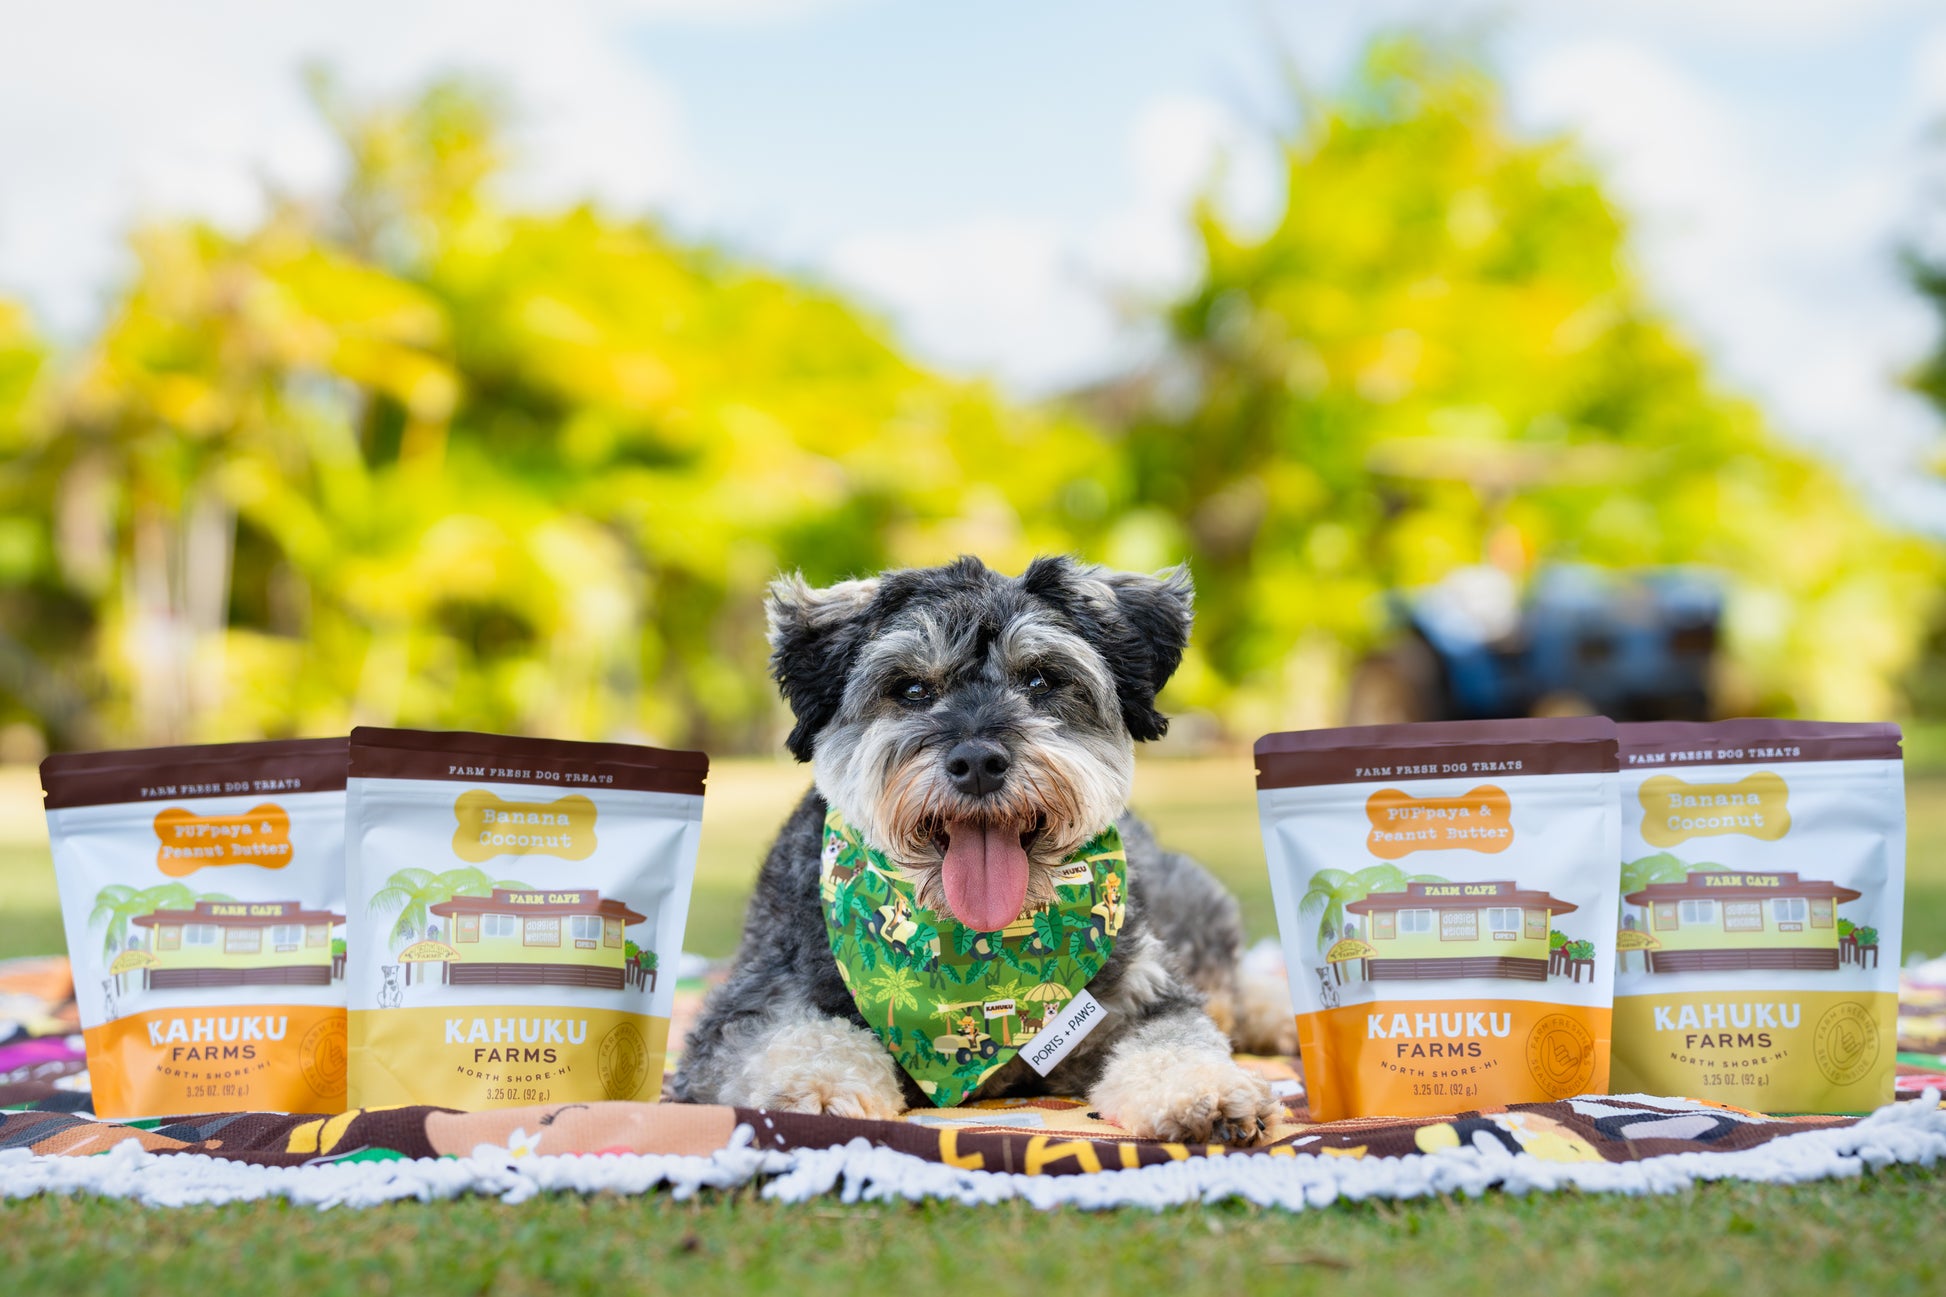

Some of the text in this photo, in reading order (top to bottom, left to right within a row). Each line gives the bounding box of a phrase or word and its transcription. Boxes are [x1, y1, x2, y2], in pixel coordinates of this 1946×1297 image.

[1629, 747, 1801, 764] FARM FRESH DOG TREATS
[449, 765, 614, 784] FARM FRESH DOG TREATS
[1355, 760, 1522, 777] FARM FRESH DOG TREATS
[141, 778, 301, 797] FARM FRESH DOG TREATS
[1667, 792, 1760, 808] Banana
[482, 808, 570, 827] Banana
[1480, 804, 1491, 816] &
[260, 822, 272, 834] &
[1667, 812, 1764, 830] Coconut
[479, 831, 572, 849] Coconut
[1373, 825, 1509, 842] Peanut Butter
[162, 842, 289, 859] Peanut Butter
[1705, 875, 1779, 886] FARM CAFE
[510, 893, 580, 904] FARM CAFE
[1424, 885, 1497, 896] FARM CAFE
[212, 904, 282, 916] FARM CAFE
[1654, 1003, 1800, 1031] KAHUKU
[147, 1016, 288, 1046] KAHUKU
[445, 1018, 588, 1045] KAHUKU
[1367, 1012, 1511, 1039] KAHUKU
[1032, 1035, 1064, 1066] PORTS
[1068, 1002, 1096, 1031] PAWS
[1531, 1023, 1548, 1049] FARM
[1686, 1033, 1772, 1049] FARMS
[172, 1045, 257, 1061] FARMS
[474, 1048, 557, 1063] FARMS
[1397, 1042, 1482, 1057] FARMS
[1670, 1052, 1715, 1068] NORTH
[156, 1065, 199, 1079] NORTH
[457, 1065, 500, 1082] NORTH
[1380, 1061, 1425, 1077] NORTH
[1703, 1074, 1769, 1086] 3.25 OZ. (92 g.)
[487, 1089, 550, 1102] 3.25 OZ. (92 g.)
[1413, 1084, 1478, 1096] 3.25 OZ. (92 g.)
